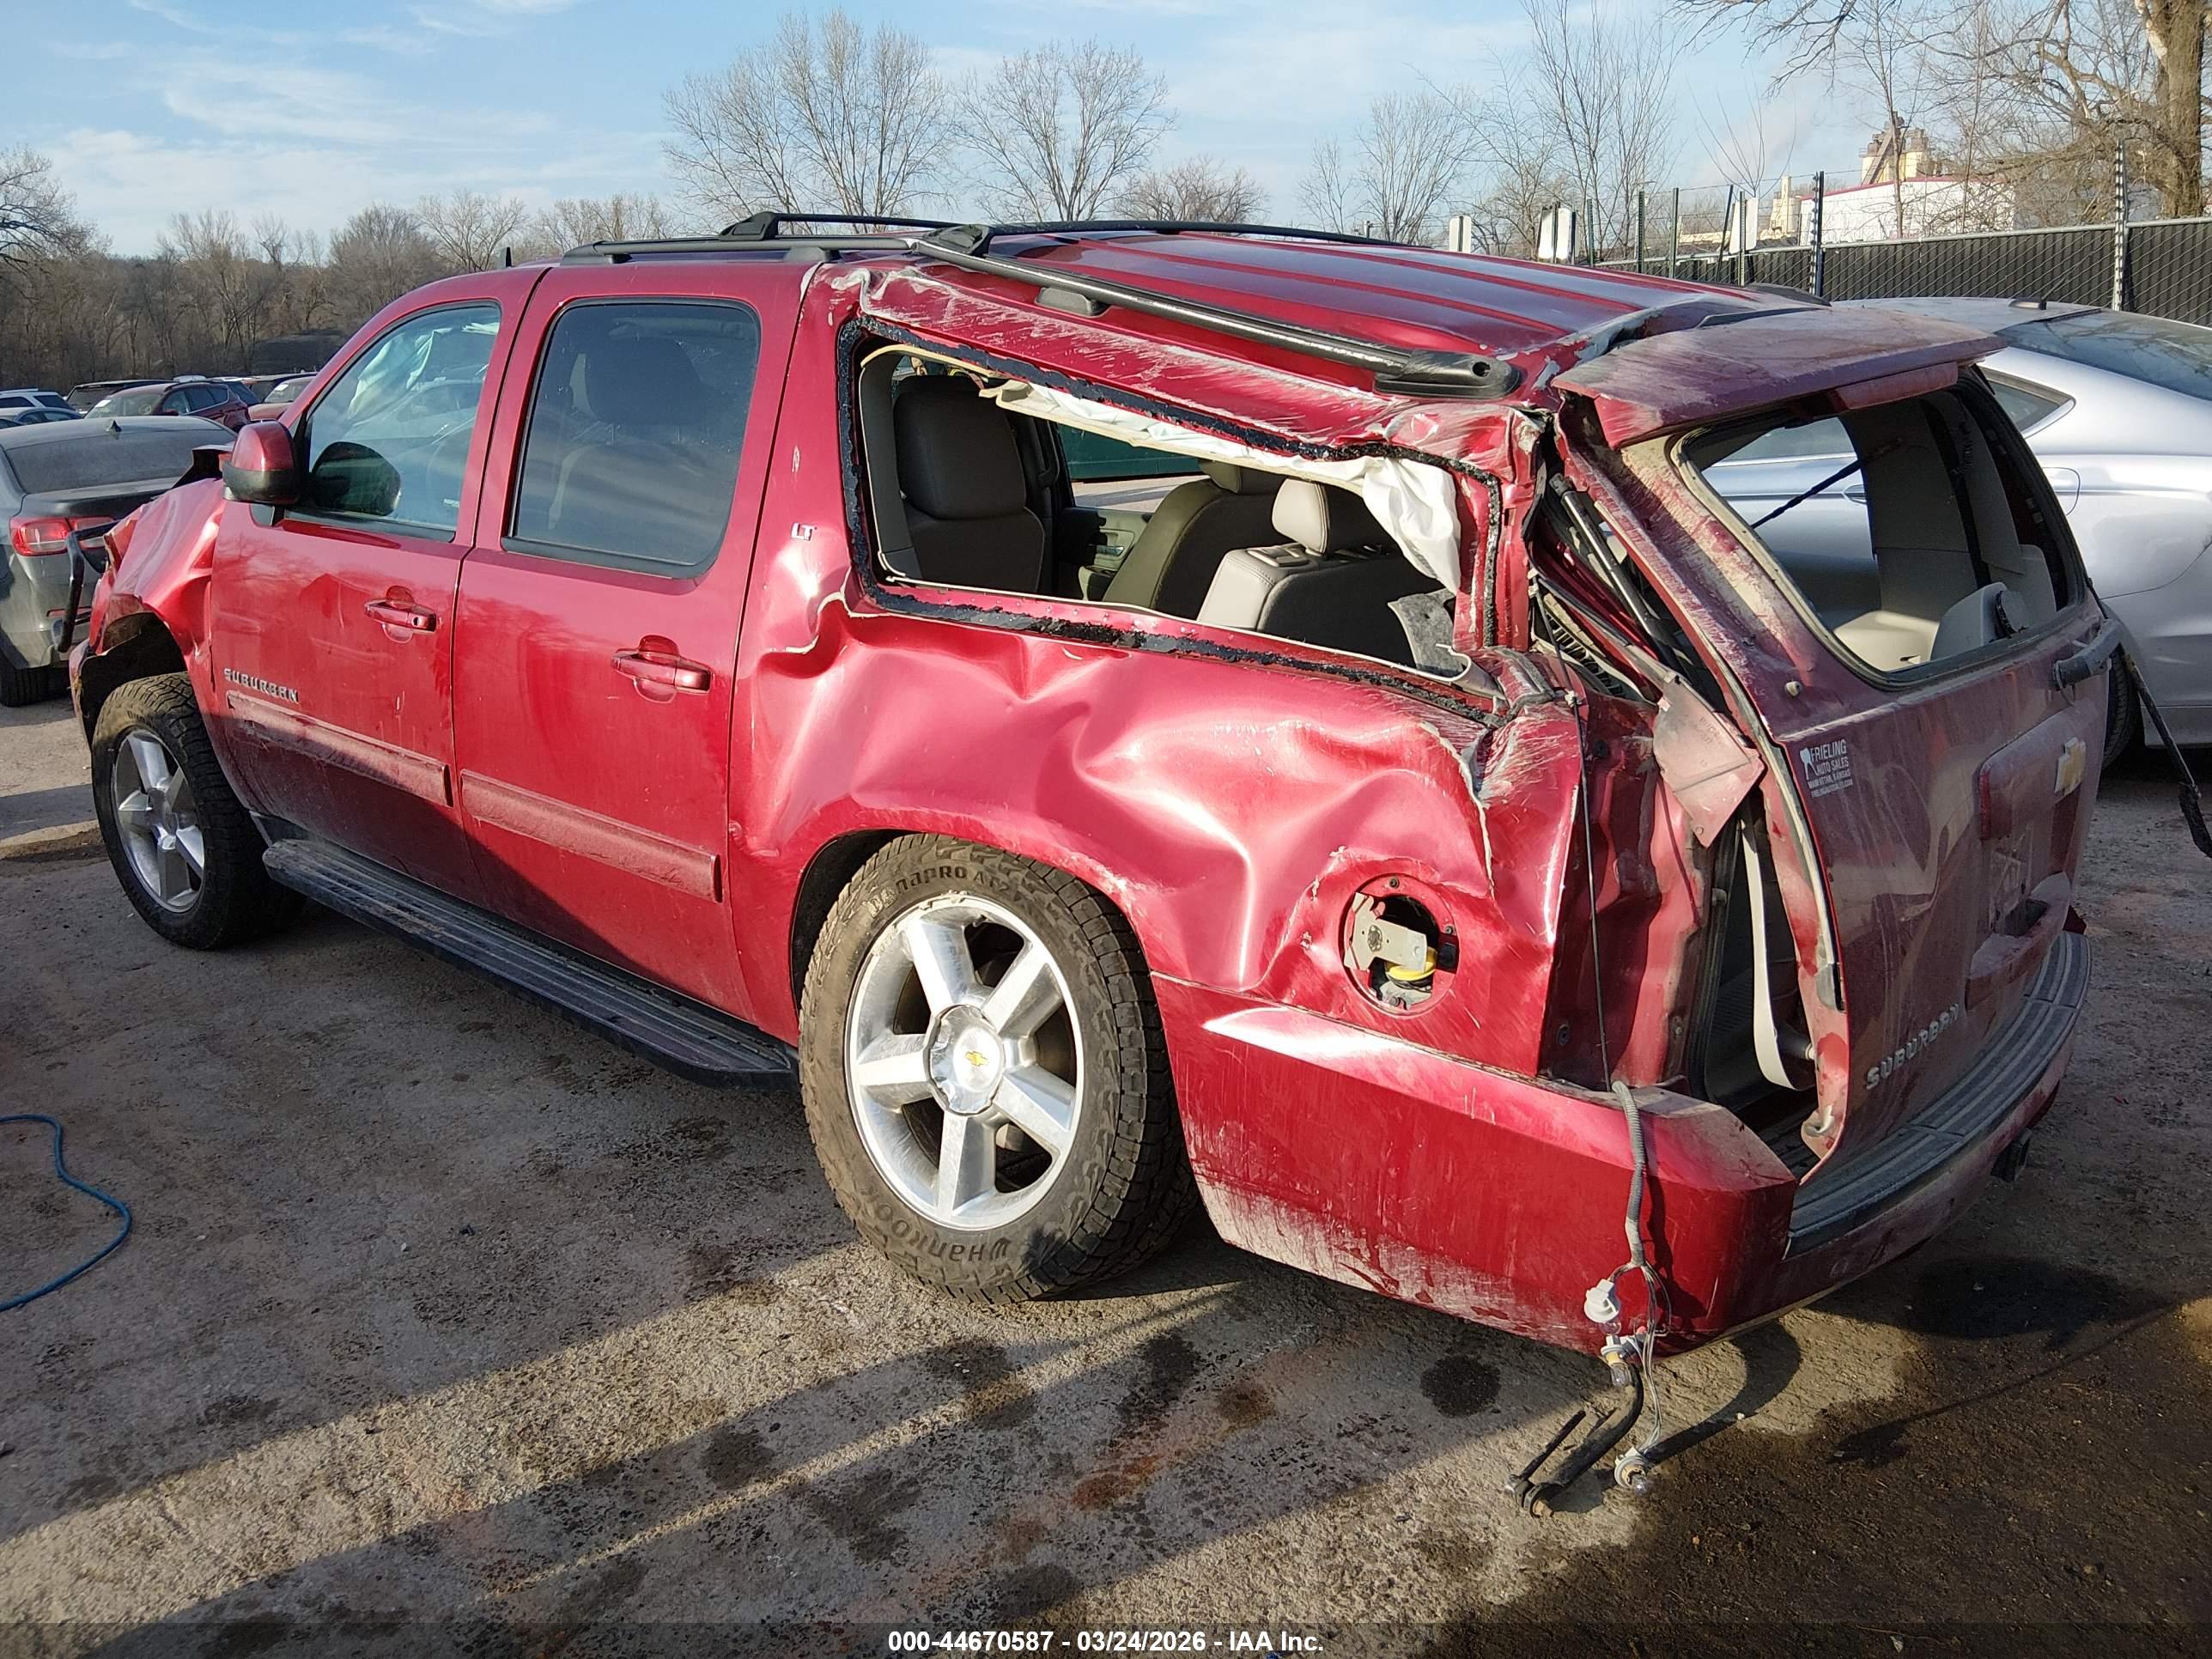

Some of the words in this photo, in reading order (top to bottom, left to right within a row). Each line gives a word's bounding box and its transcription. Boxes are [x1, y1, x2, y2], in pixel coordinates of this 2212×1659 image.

[791, 522, 816, 541] LT
[224, 668, 299, 704] SUBURBAN
[1810, 739, 1847, 763] FRIELING
[1816, 762, 1831, 775] AUTO
[1831, 757, 1849, 771] SALES
[1866, 1003, 1959, 1090] SUBURBAN
